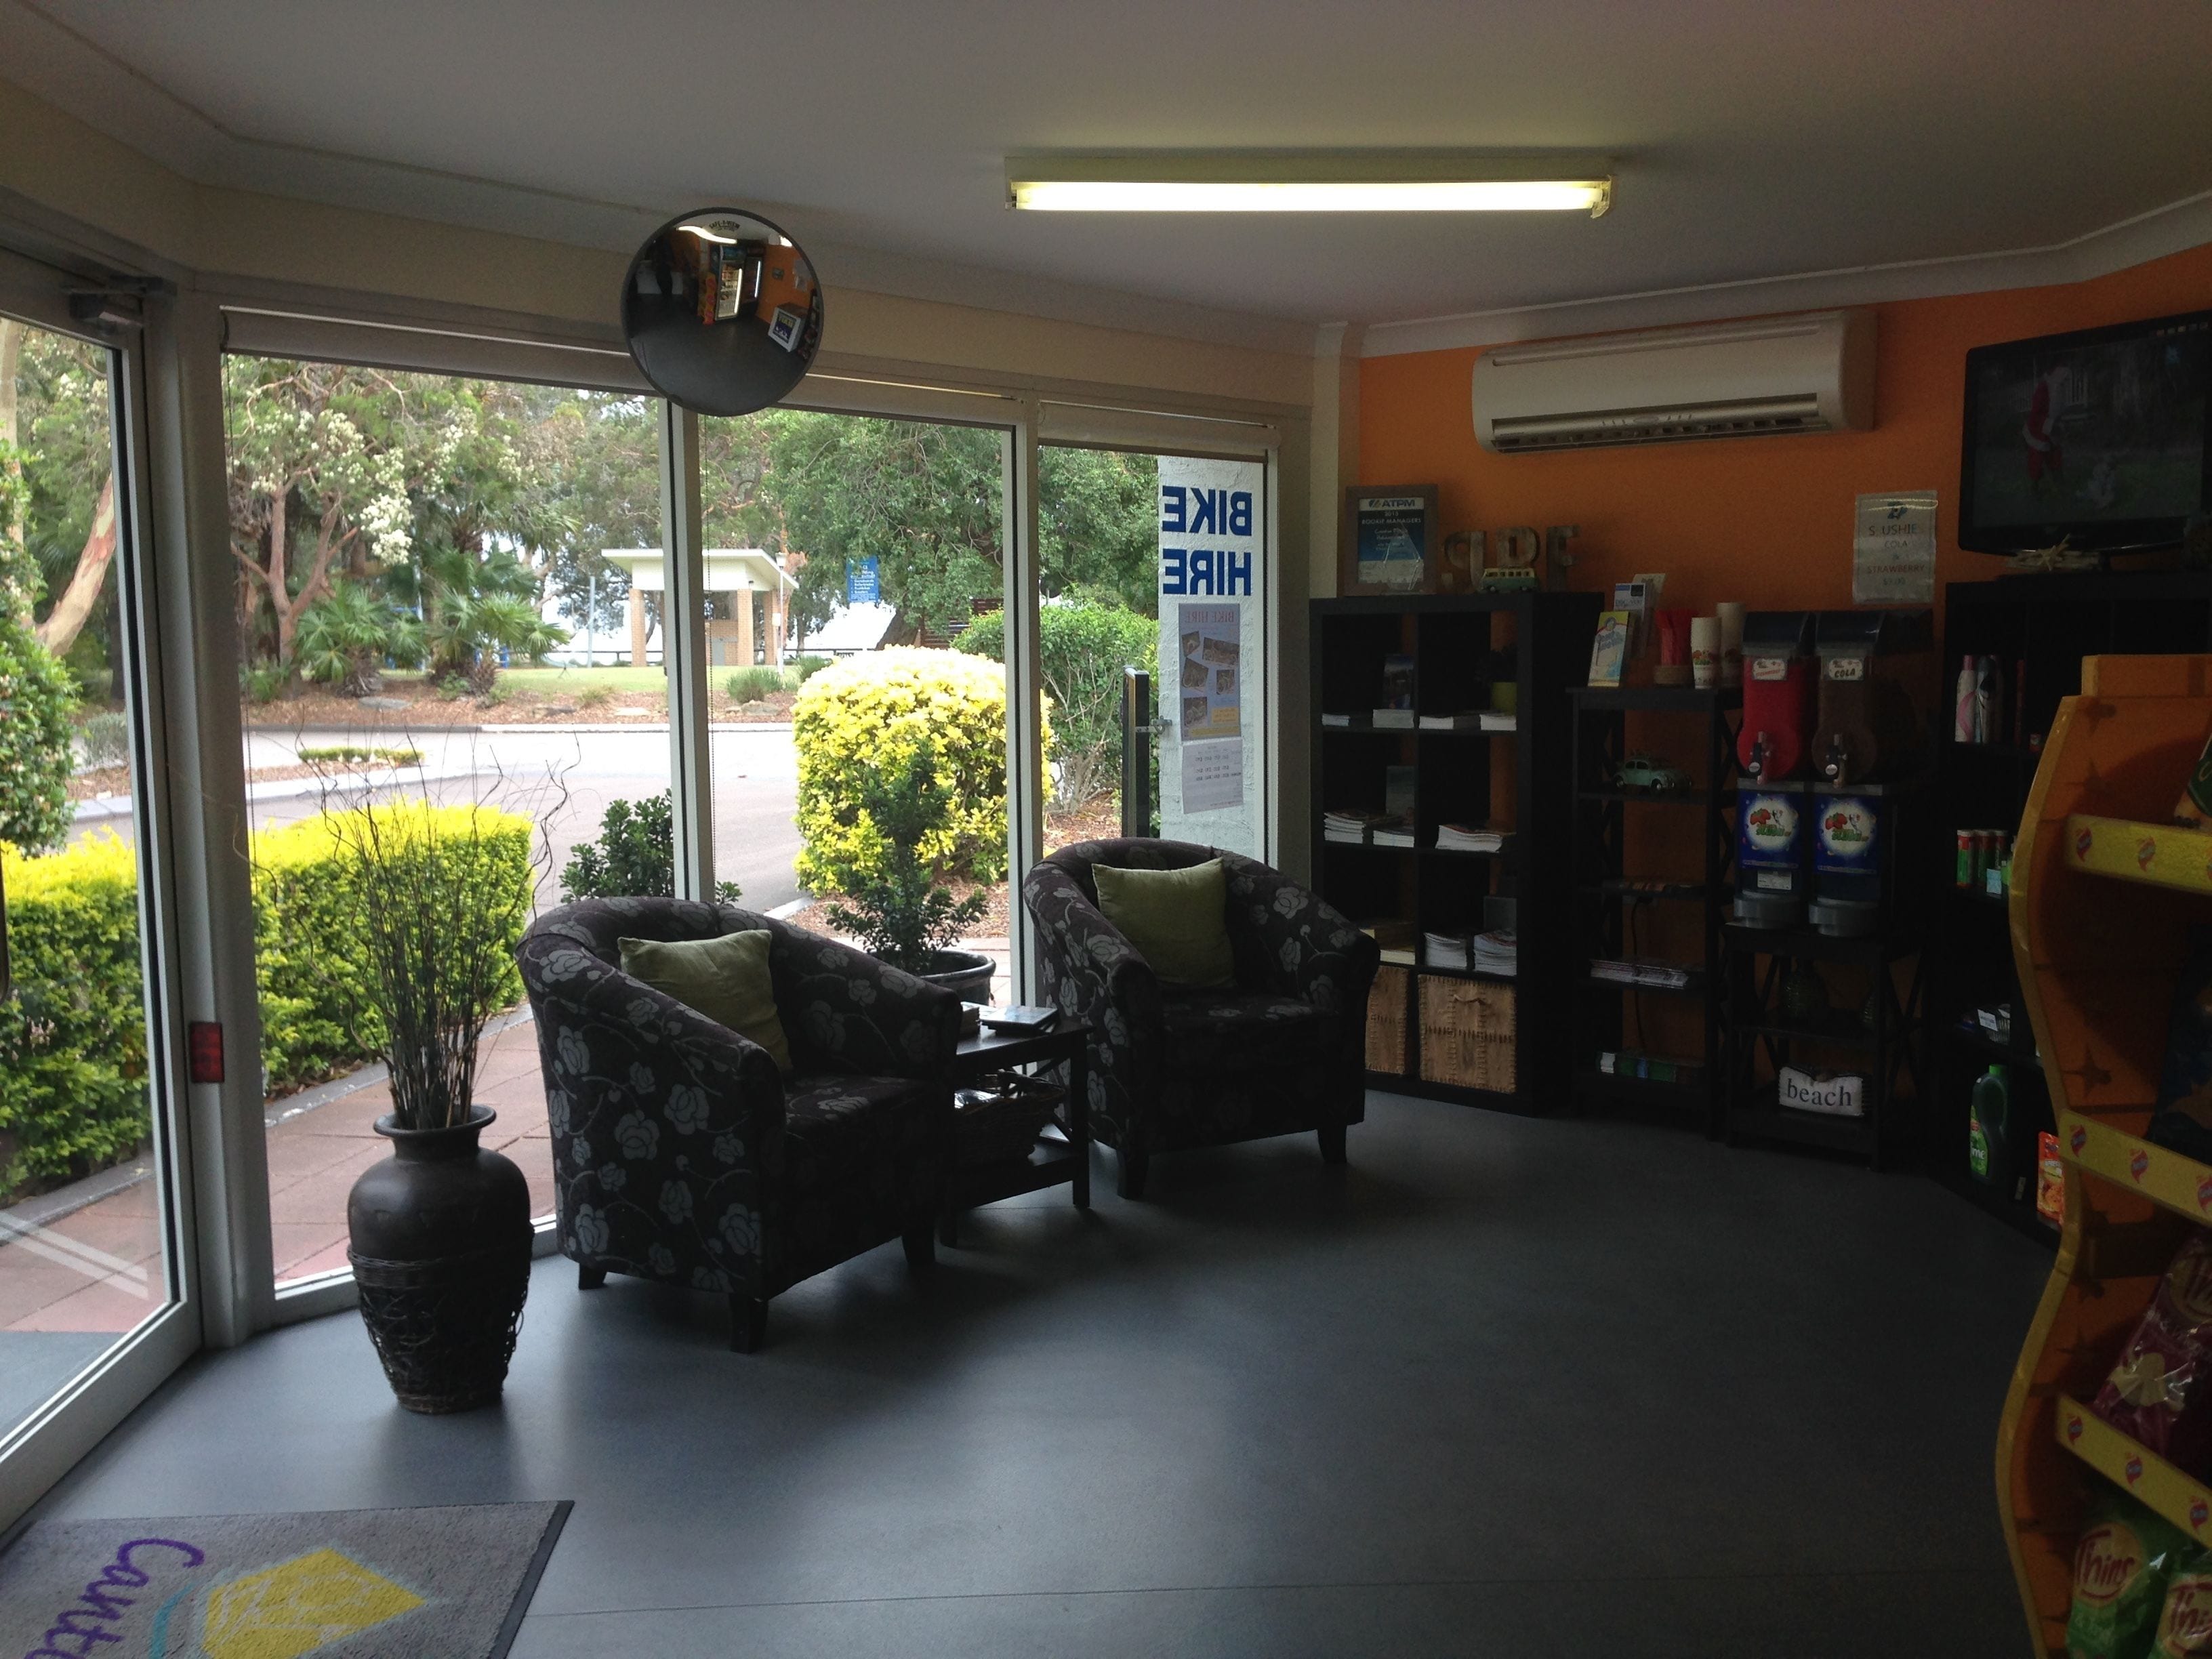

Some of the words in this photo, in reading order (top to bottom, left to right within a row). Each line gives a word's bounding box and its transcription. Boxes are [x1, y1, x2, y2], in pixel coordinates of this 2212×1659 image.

[1382, 499, 1415, 508] ATPM
[1868, 564, 1925, 574] STRAWBERRY
[1835, 668, 1856, 678] COLA
[1787, 1078, 1852, 1106] beach
[2075, 1528, 2135, 1586] Thins
